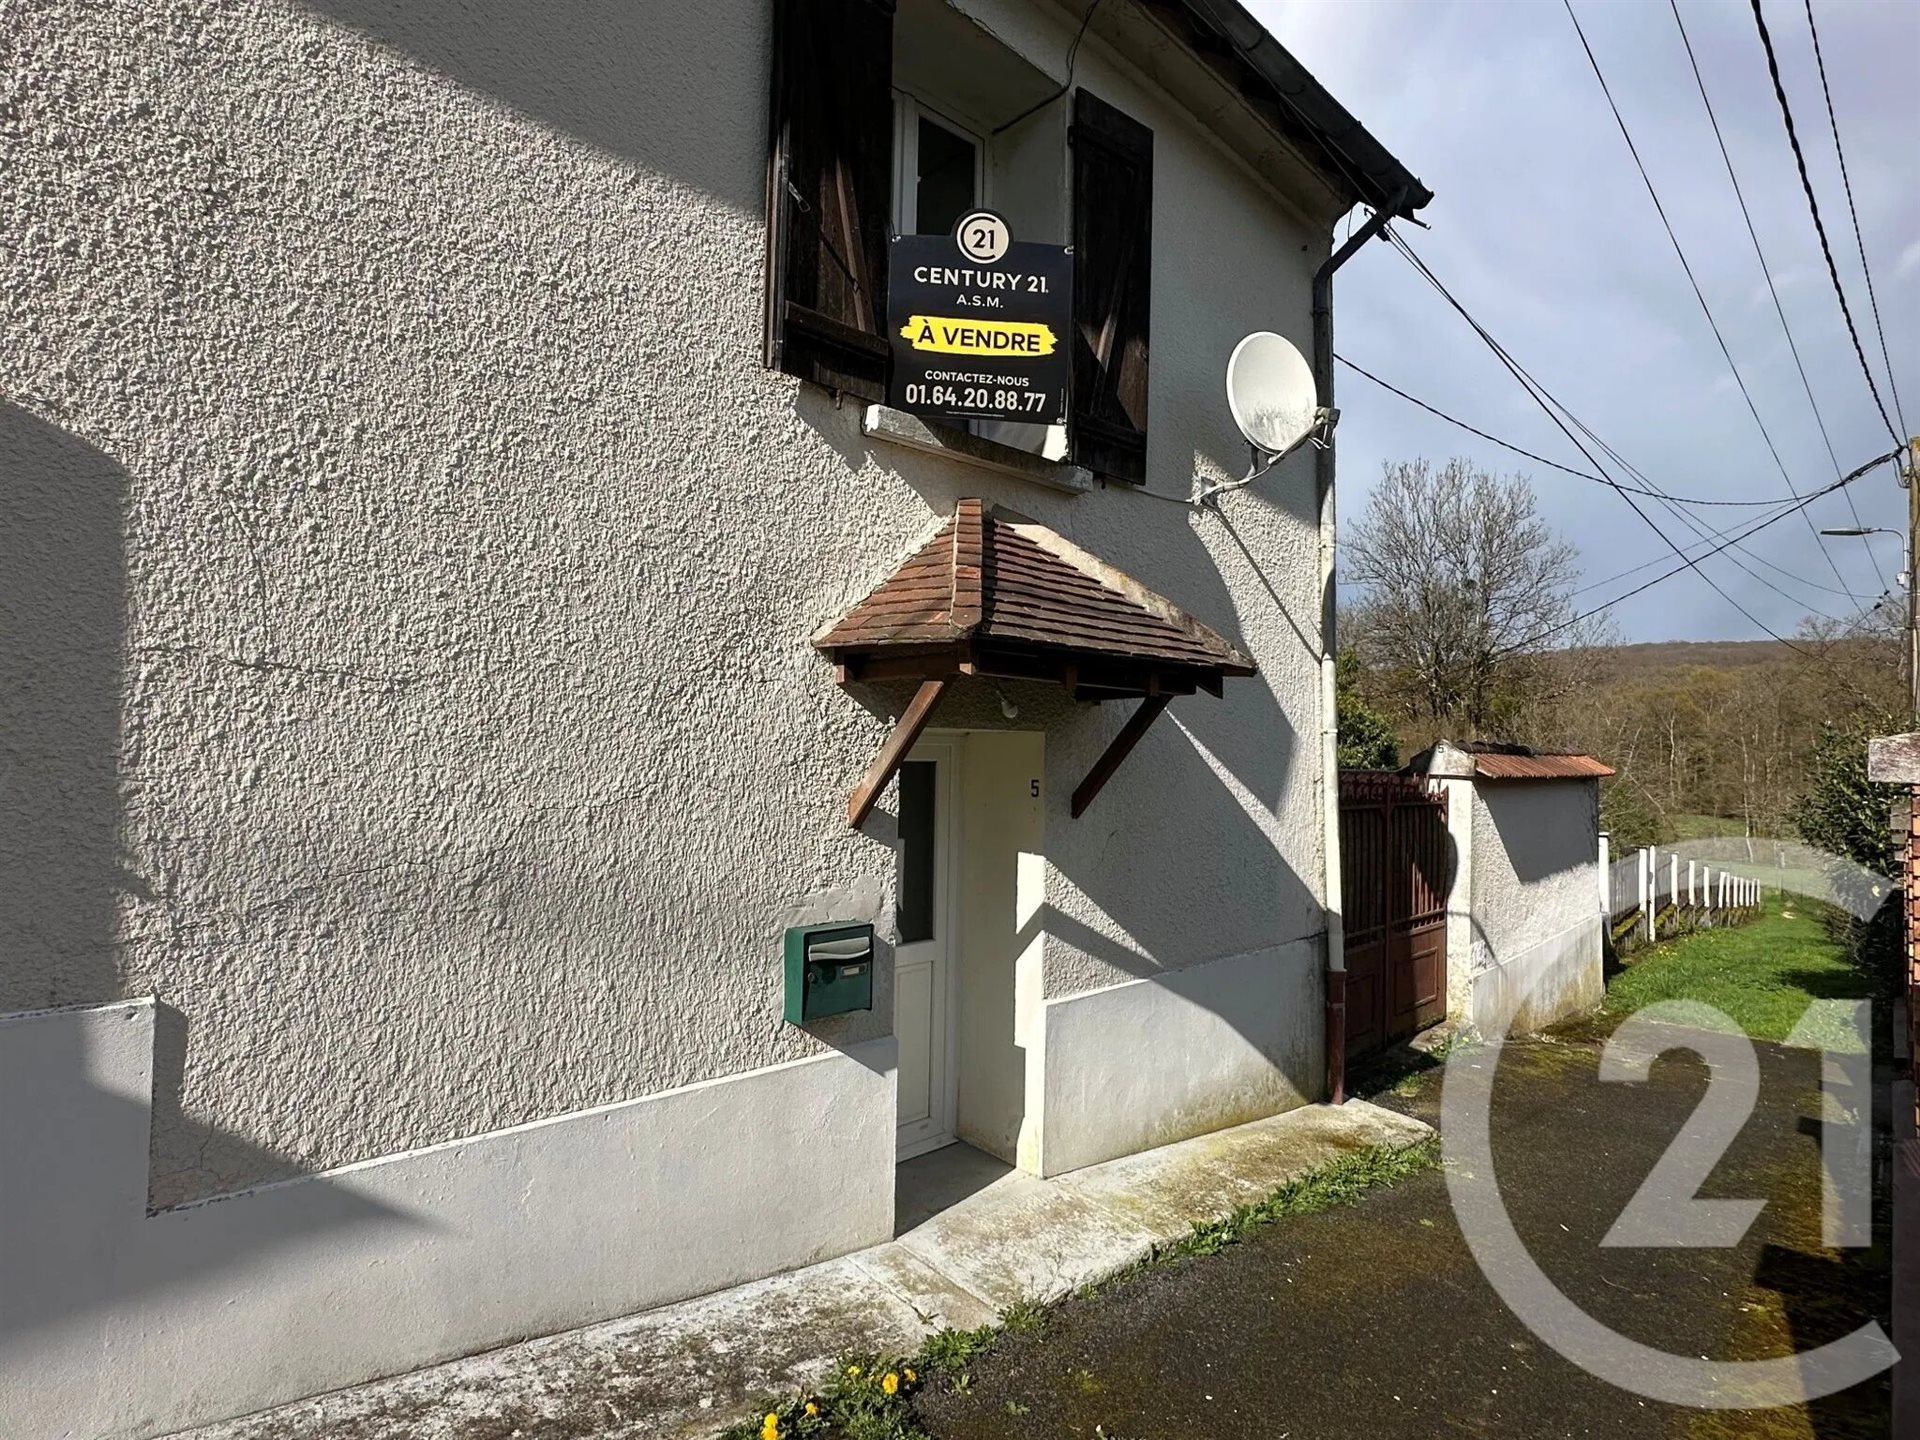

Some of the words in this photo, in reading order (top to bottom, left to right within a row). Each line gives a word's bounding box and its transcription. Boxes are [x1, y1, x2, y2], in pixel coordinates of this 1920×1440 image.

[914, 267, 1021, 291] CENTURY
[956, 294, 1004, 308] A.S.M.
[918, 321, 935, 344] À
[943, 326, 1041, 352] VENDRE
[925, 370, 1030, 387] CONTACTEZ-NOUS
[905, 384, 1046, 412] 01.64.20.88.77
[1438, 743, 1445, 753] 5
[1031, 779, 1040, 798] 5
